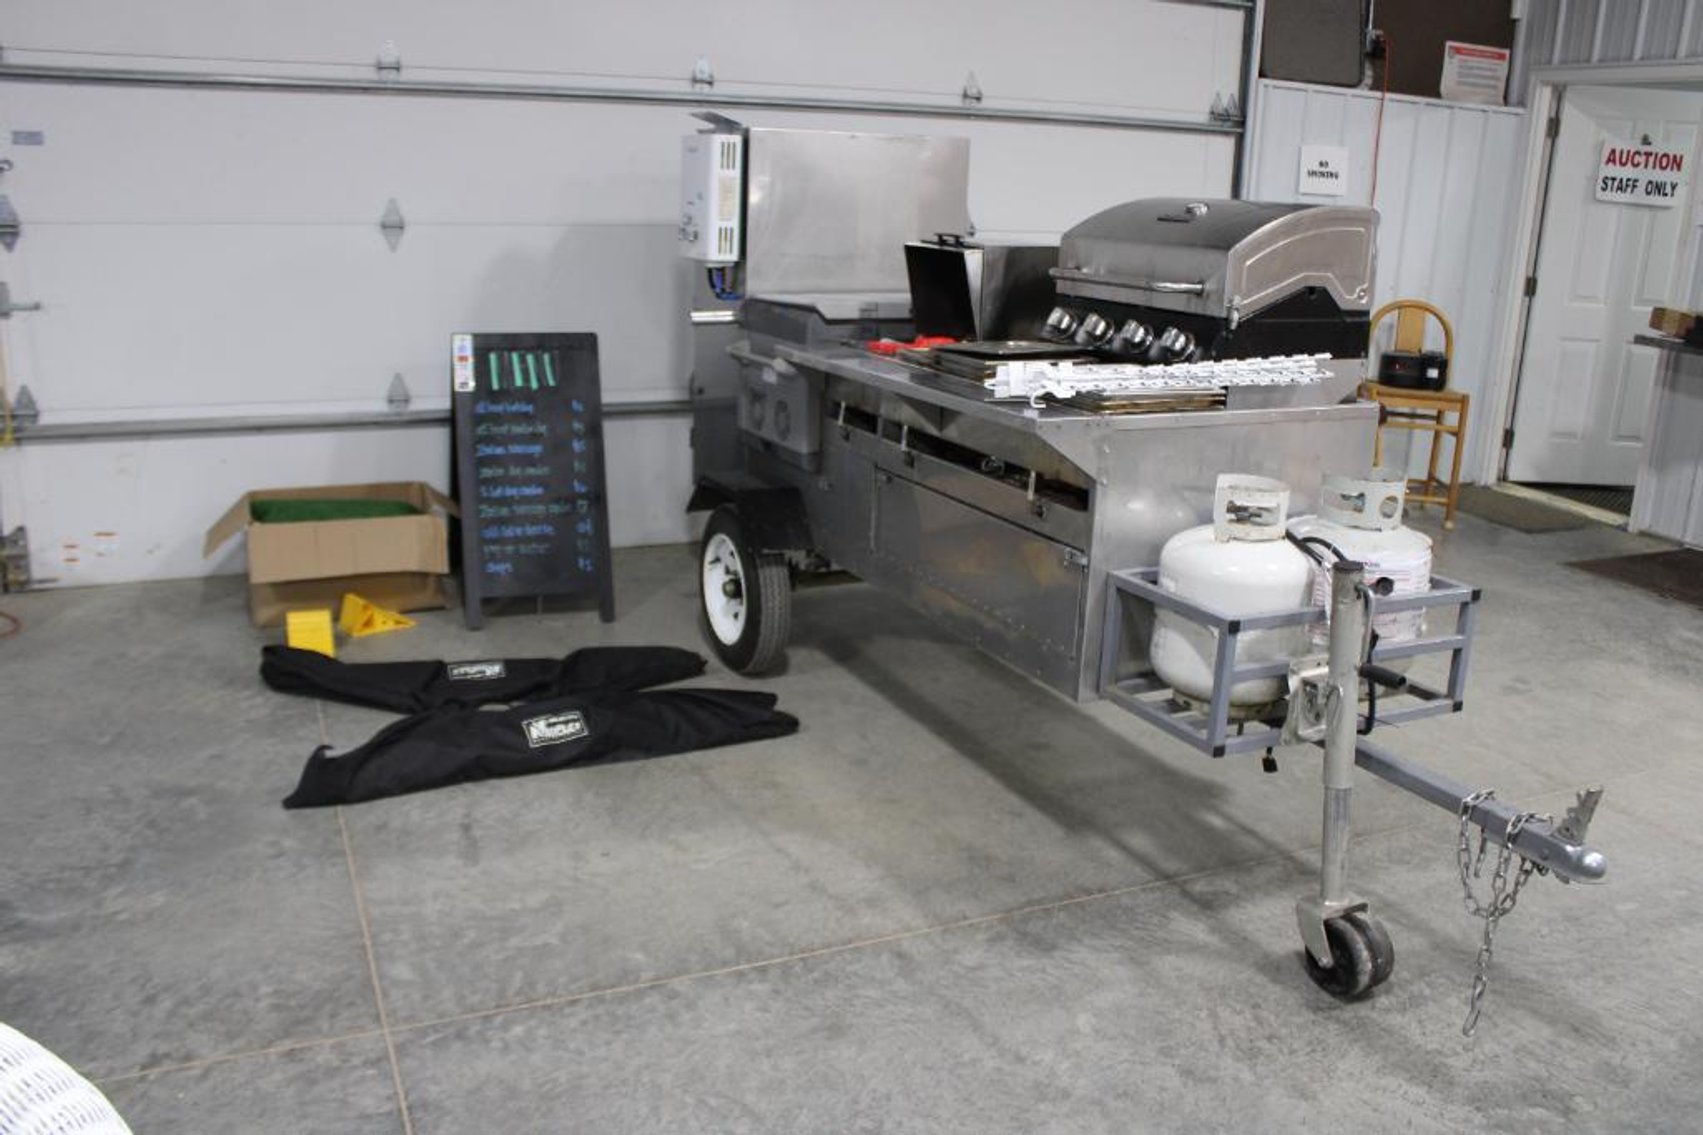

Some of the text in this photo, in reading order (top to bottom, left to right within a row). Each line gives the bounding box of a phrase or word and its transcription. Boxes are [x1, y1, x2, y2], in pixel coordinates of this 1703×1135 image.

[1605, 147, 1684, 172] AUCTION
[1600, 176, 1679, 198] STAFF ONLY
